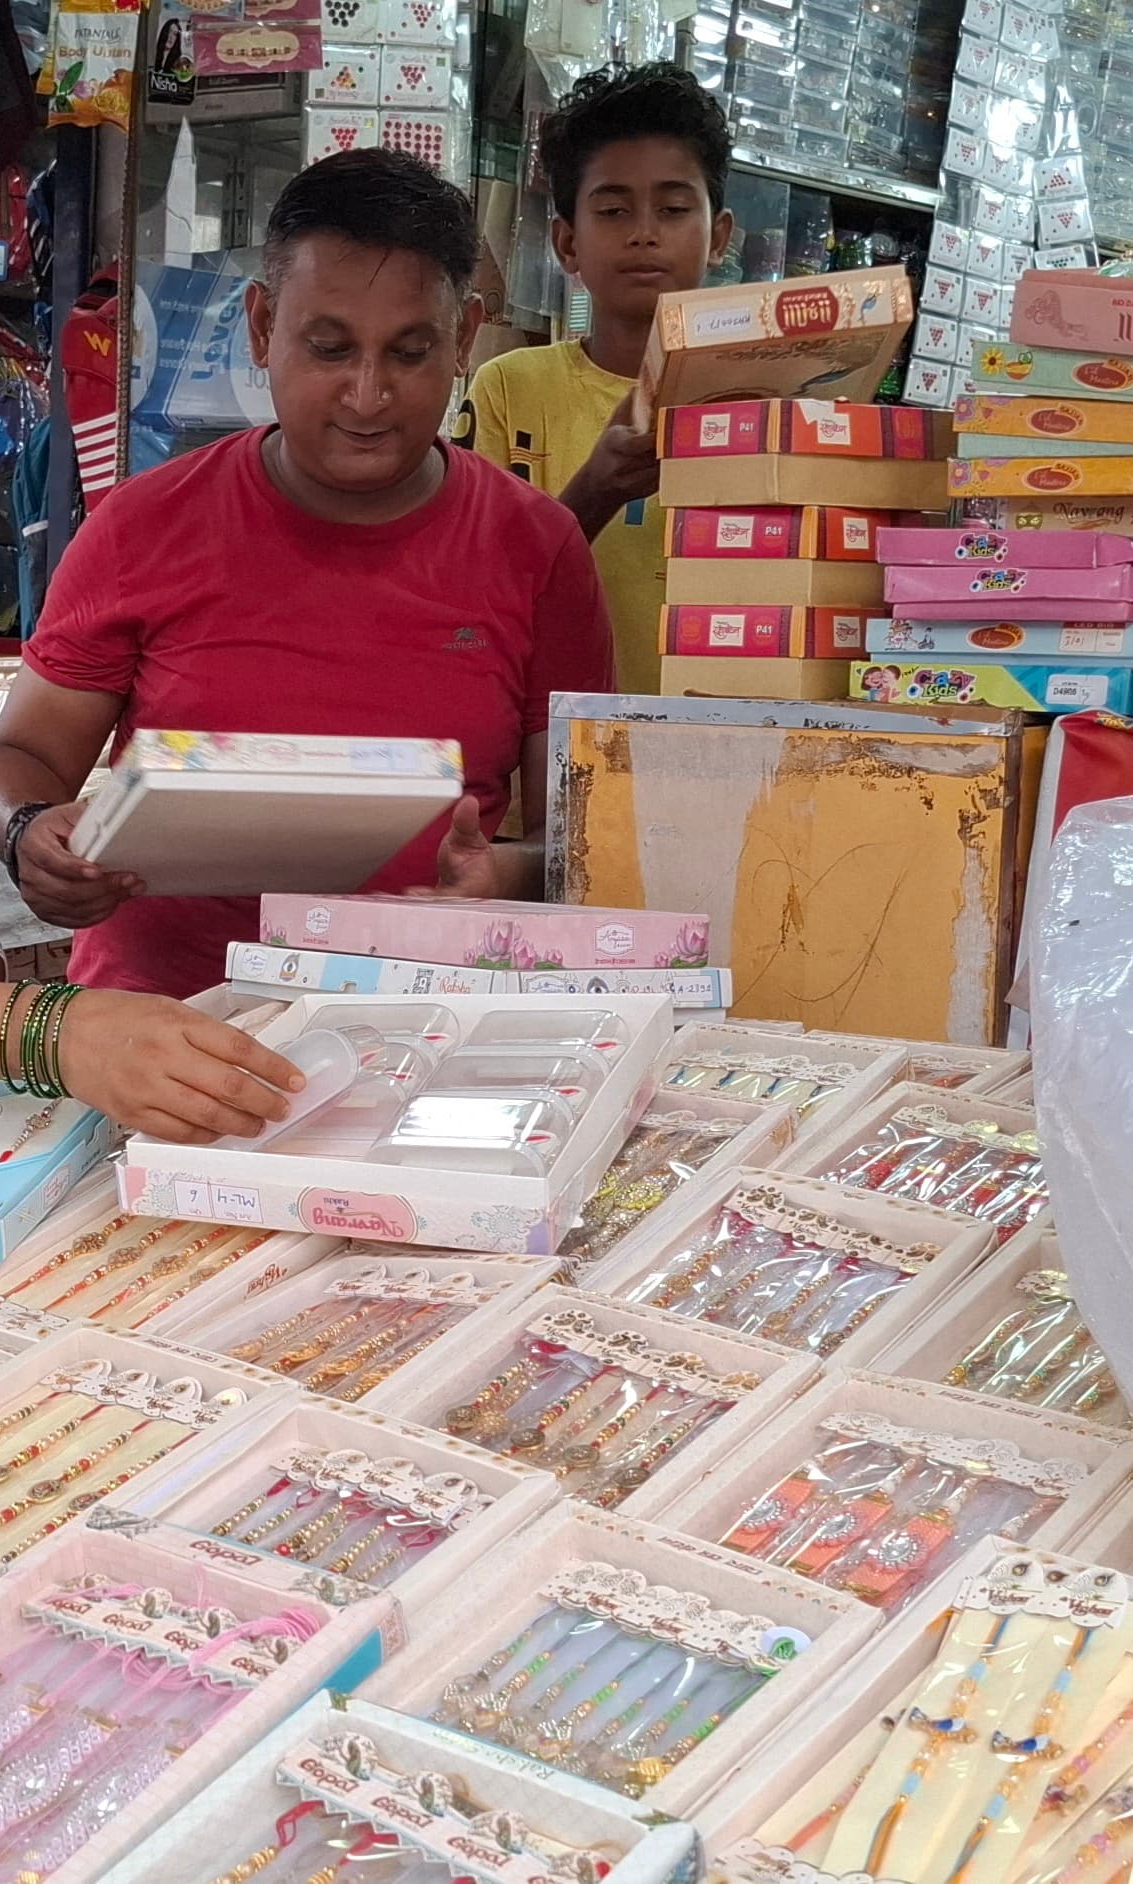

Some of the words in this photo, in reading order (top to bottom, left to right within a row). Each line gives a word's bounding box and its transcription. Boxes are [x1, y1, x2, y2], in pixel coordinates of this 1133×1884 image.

[150, 74, 178, 92] Nisha
[740, 422, 754, 432] P41
[1053, 502, 1125, 524] Navrang
[764, 526, 783, 536] P41
[755, 625, 773, 634] P41
[921, 684, 958, 698] Kids
[217, 1188, 256, 1208] ML-4
[312, 1207, 405, 1239] Navrang
